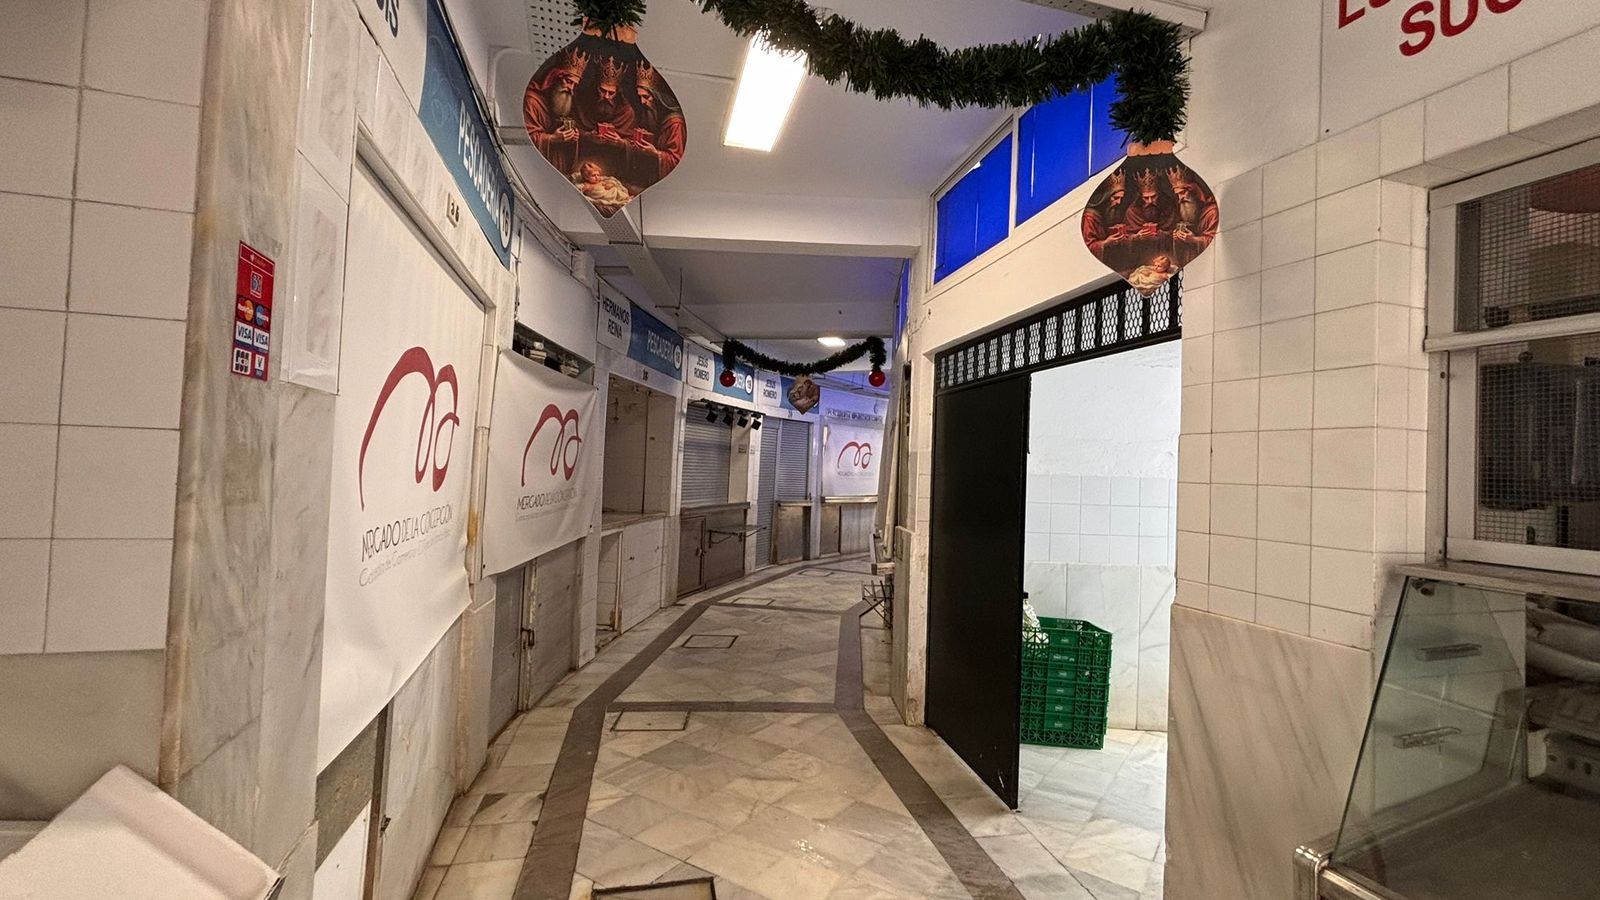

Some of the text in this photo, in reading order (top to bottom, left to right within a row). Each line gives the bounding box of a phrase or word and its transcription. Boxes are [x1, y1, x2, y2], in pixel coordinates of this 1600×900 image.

[602, 294, 630, 326] HERMANOS
[237, 326, 268, 346] VISA VISA
[607, 318, 623, 340] REINA
[693, 367, 710, 382] ROMERO
[763, 388, 778, 400] ROMERO
[516, 493, 546, 511] MERCADO
[362, 520, 401, 562] MERCADO
